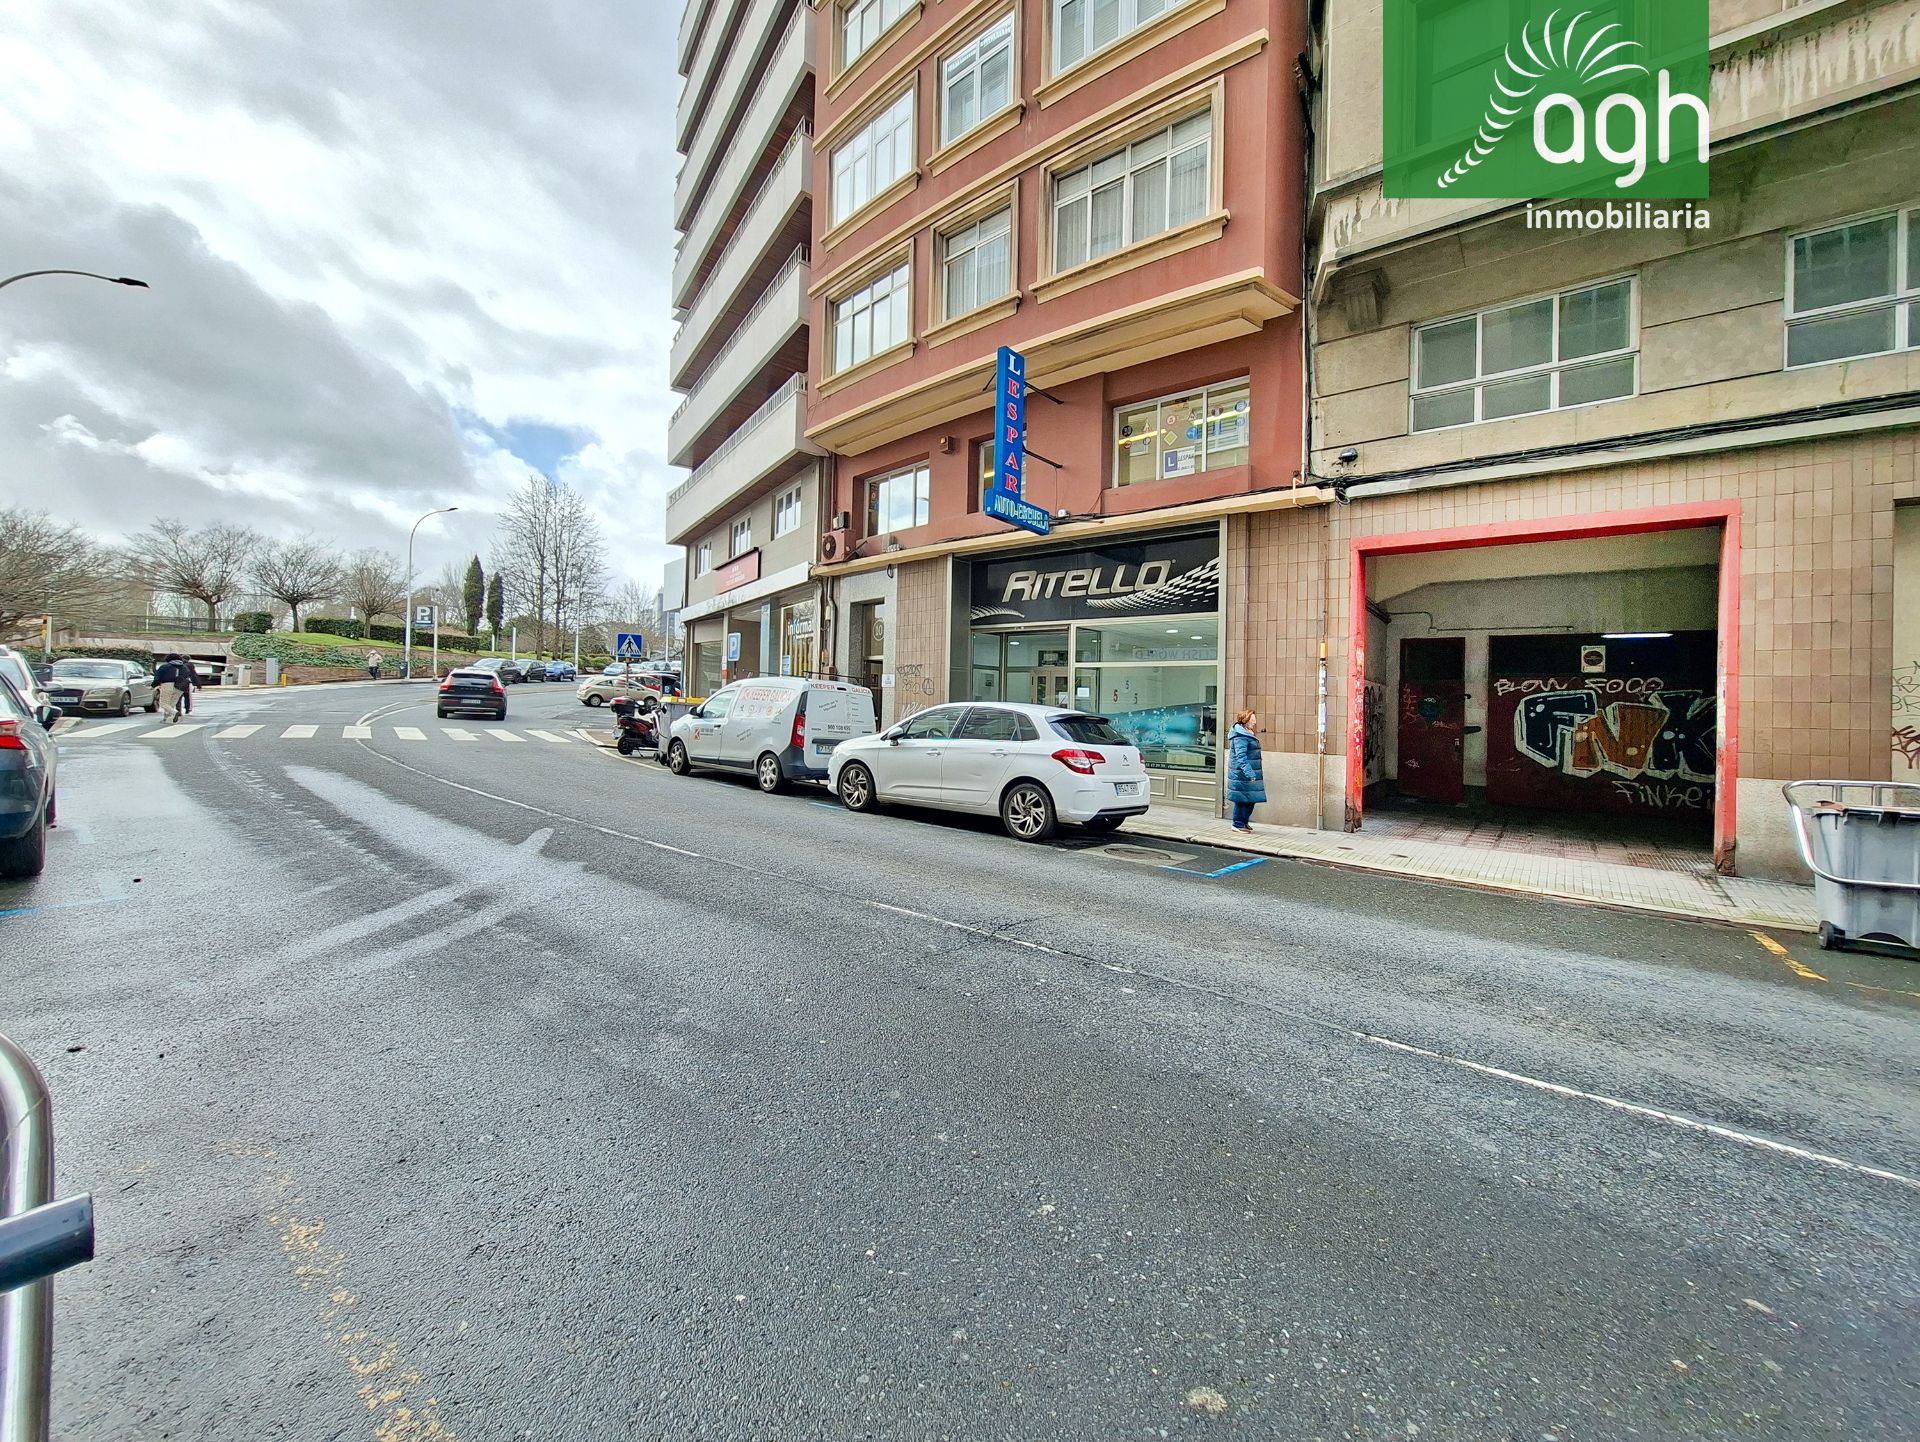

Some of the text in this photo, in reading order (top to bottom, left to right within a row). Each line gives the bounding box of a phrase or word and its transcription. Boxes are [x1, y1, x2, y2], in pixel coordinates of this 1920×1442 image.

[1004, 353, 1021, 494] LESPAR
[1168, 456, 1175, 467] L
[994, 495, 1049, 530] AUTO-ESCUELA
[1001, 559, 1171, 603] RITELLO
[729, 636, 738, 658] P
